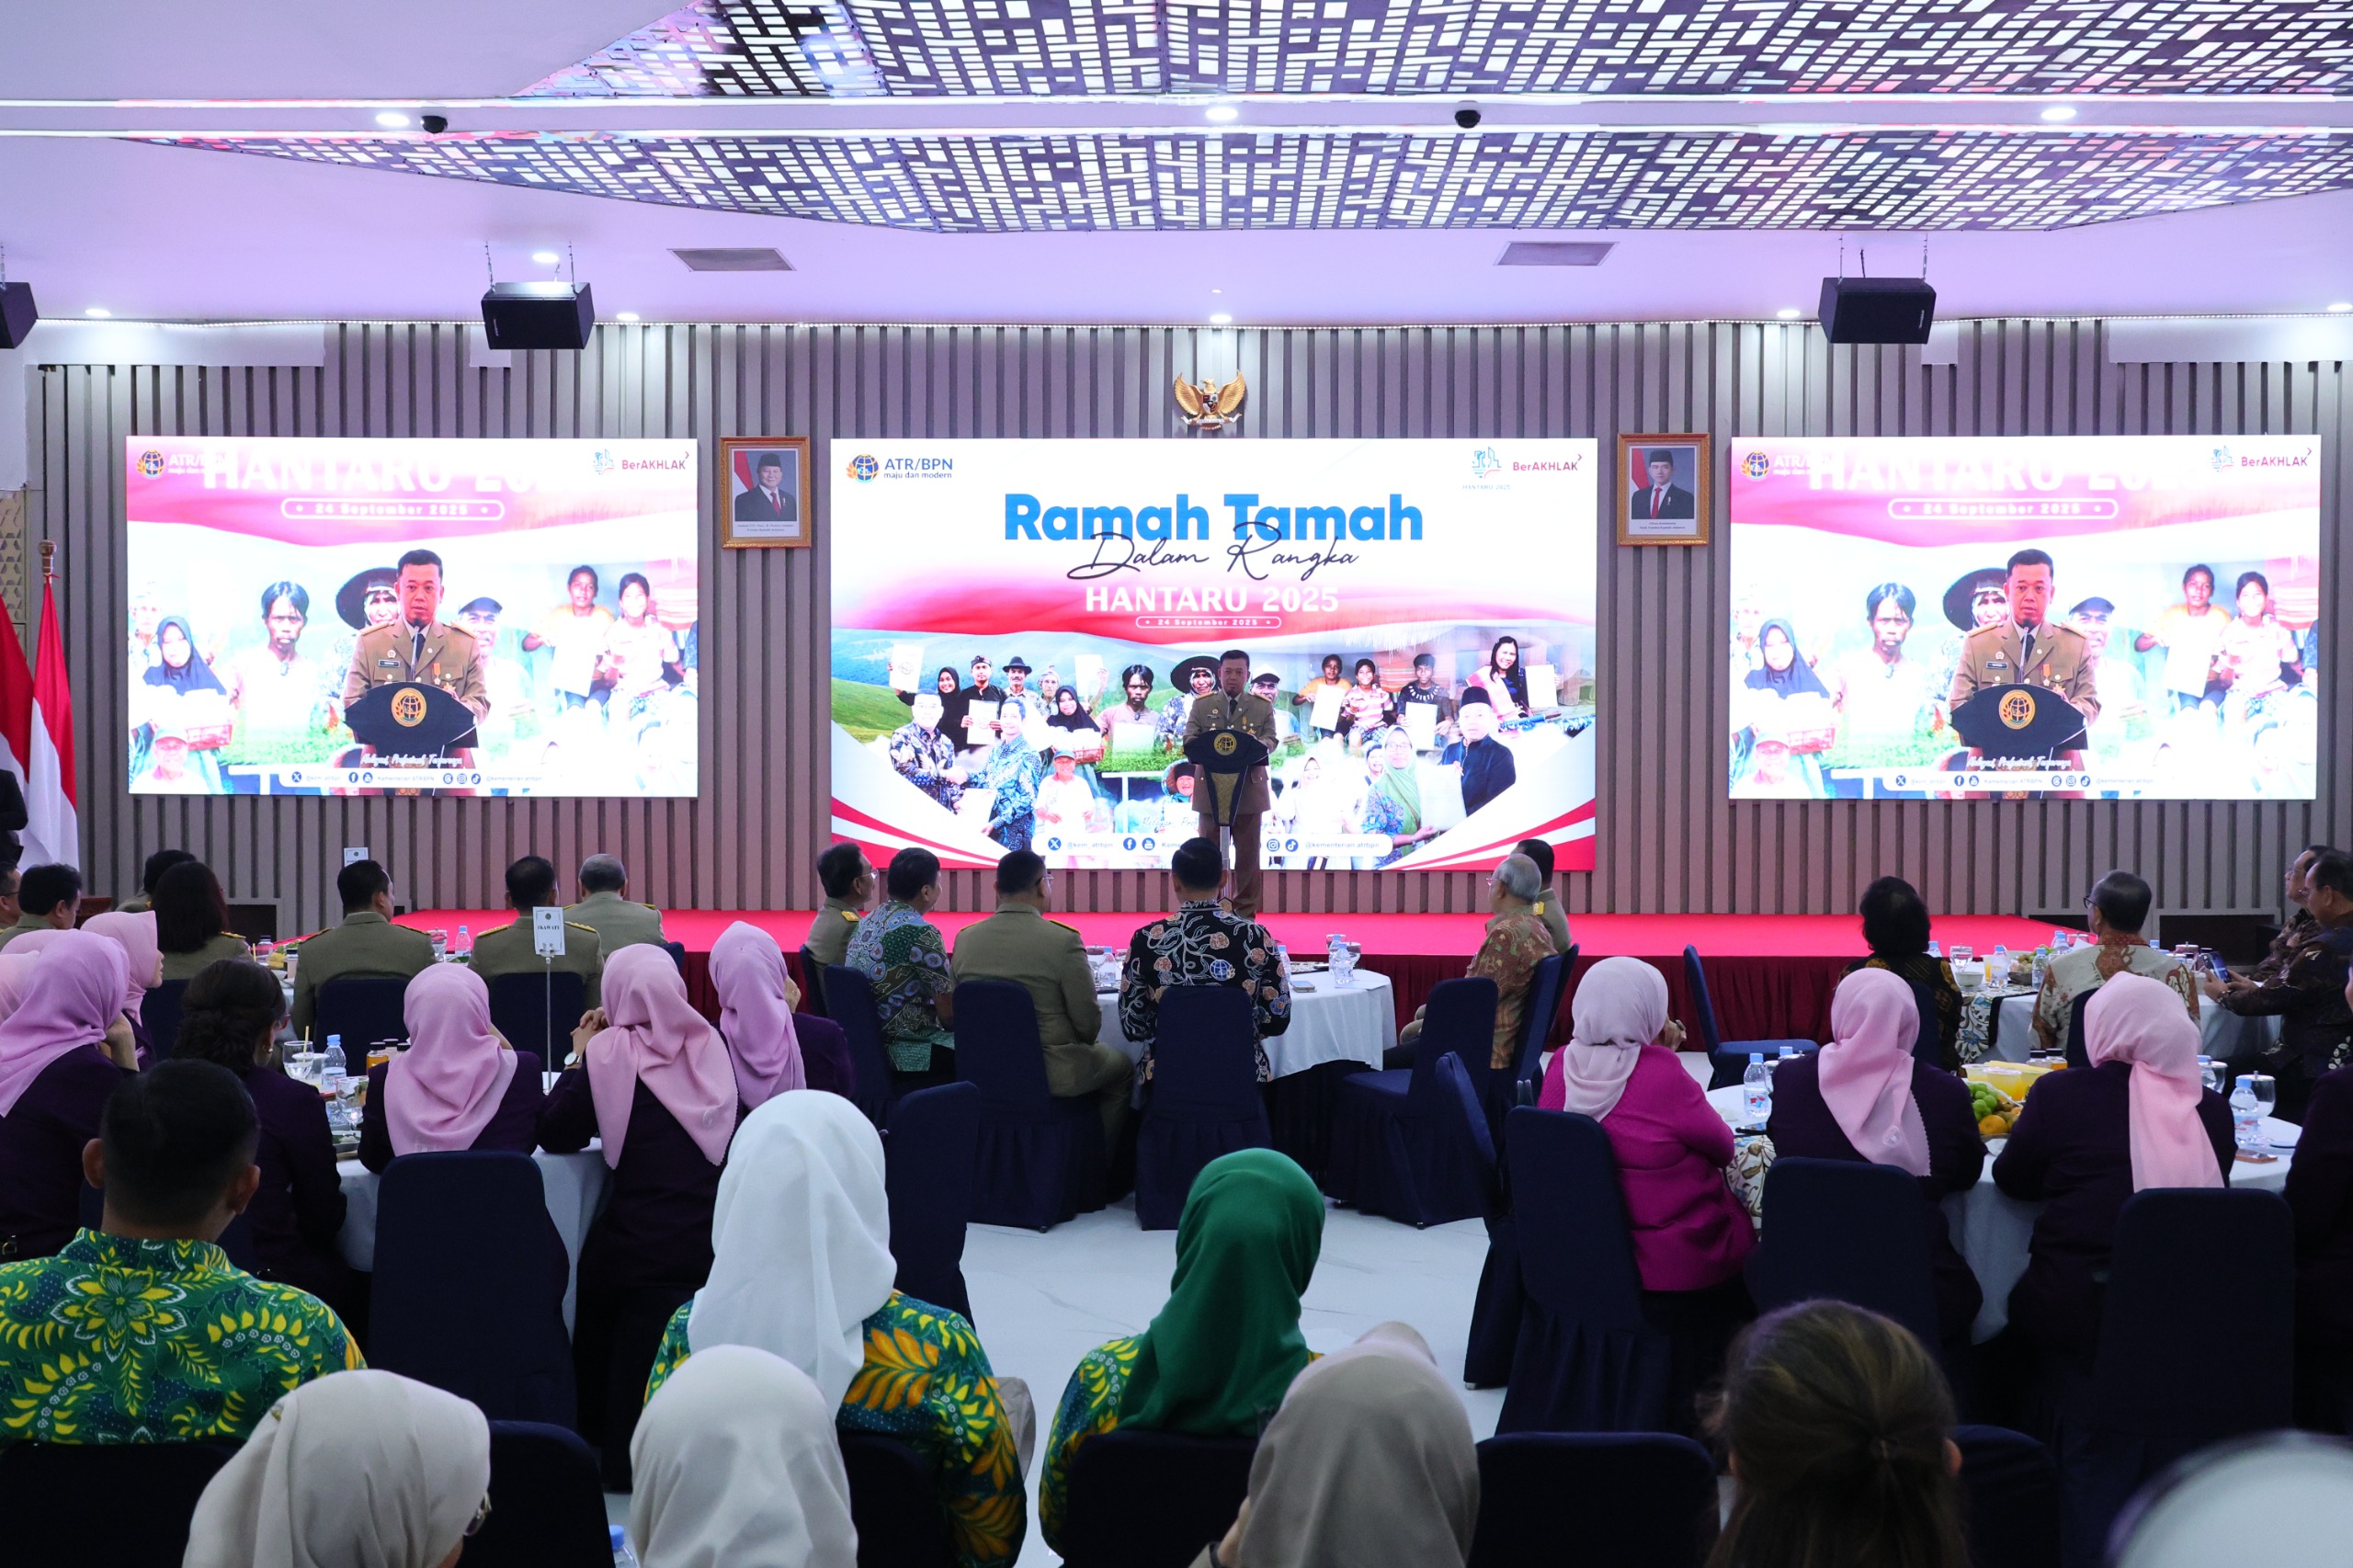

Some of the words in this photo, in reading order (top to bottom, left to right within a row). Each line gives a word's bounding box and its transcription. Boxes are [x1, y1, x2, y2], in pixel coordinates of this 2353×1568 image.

[168, 453, 227, 467] ATR/N
[621, 460, 687, 471] BerAKHLAK
[884, 458, 953, 471] ATR/BPN
[1512, 461, 1578, 472] BerAKHLAK
[1774, 454, 1832, 468] ATR/N
[2241, 456, 2308, 467] BerAKHLAK
[883, 472, 903, 480] maju
[904, 471, 920, 479] dan
[921, 471, 952, 479] modern
[340, 503, 423, 517] September
[1005, 494, 1210, 540] Ramah
[1223, 494, 1423, 540] Tamah
[1949, 503, 2034, 517] September
[1066, 531, 1210, 581] Dalam
[1226, 521, 1360, 582] Rangka
[1086, 586, 1247, 612] HANTARU
[1262, 586, 1339, 612] 2025
[1174, 619, 1228, 627] September
